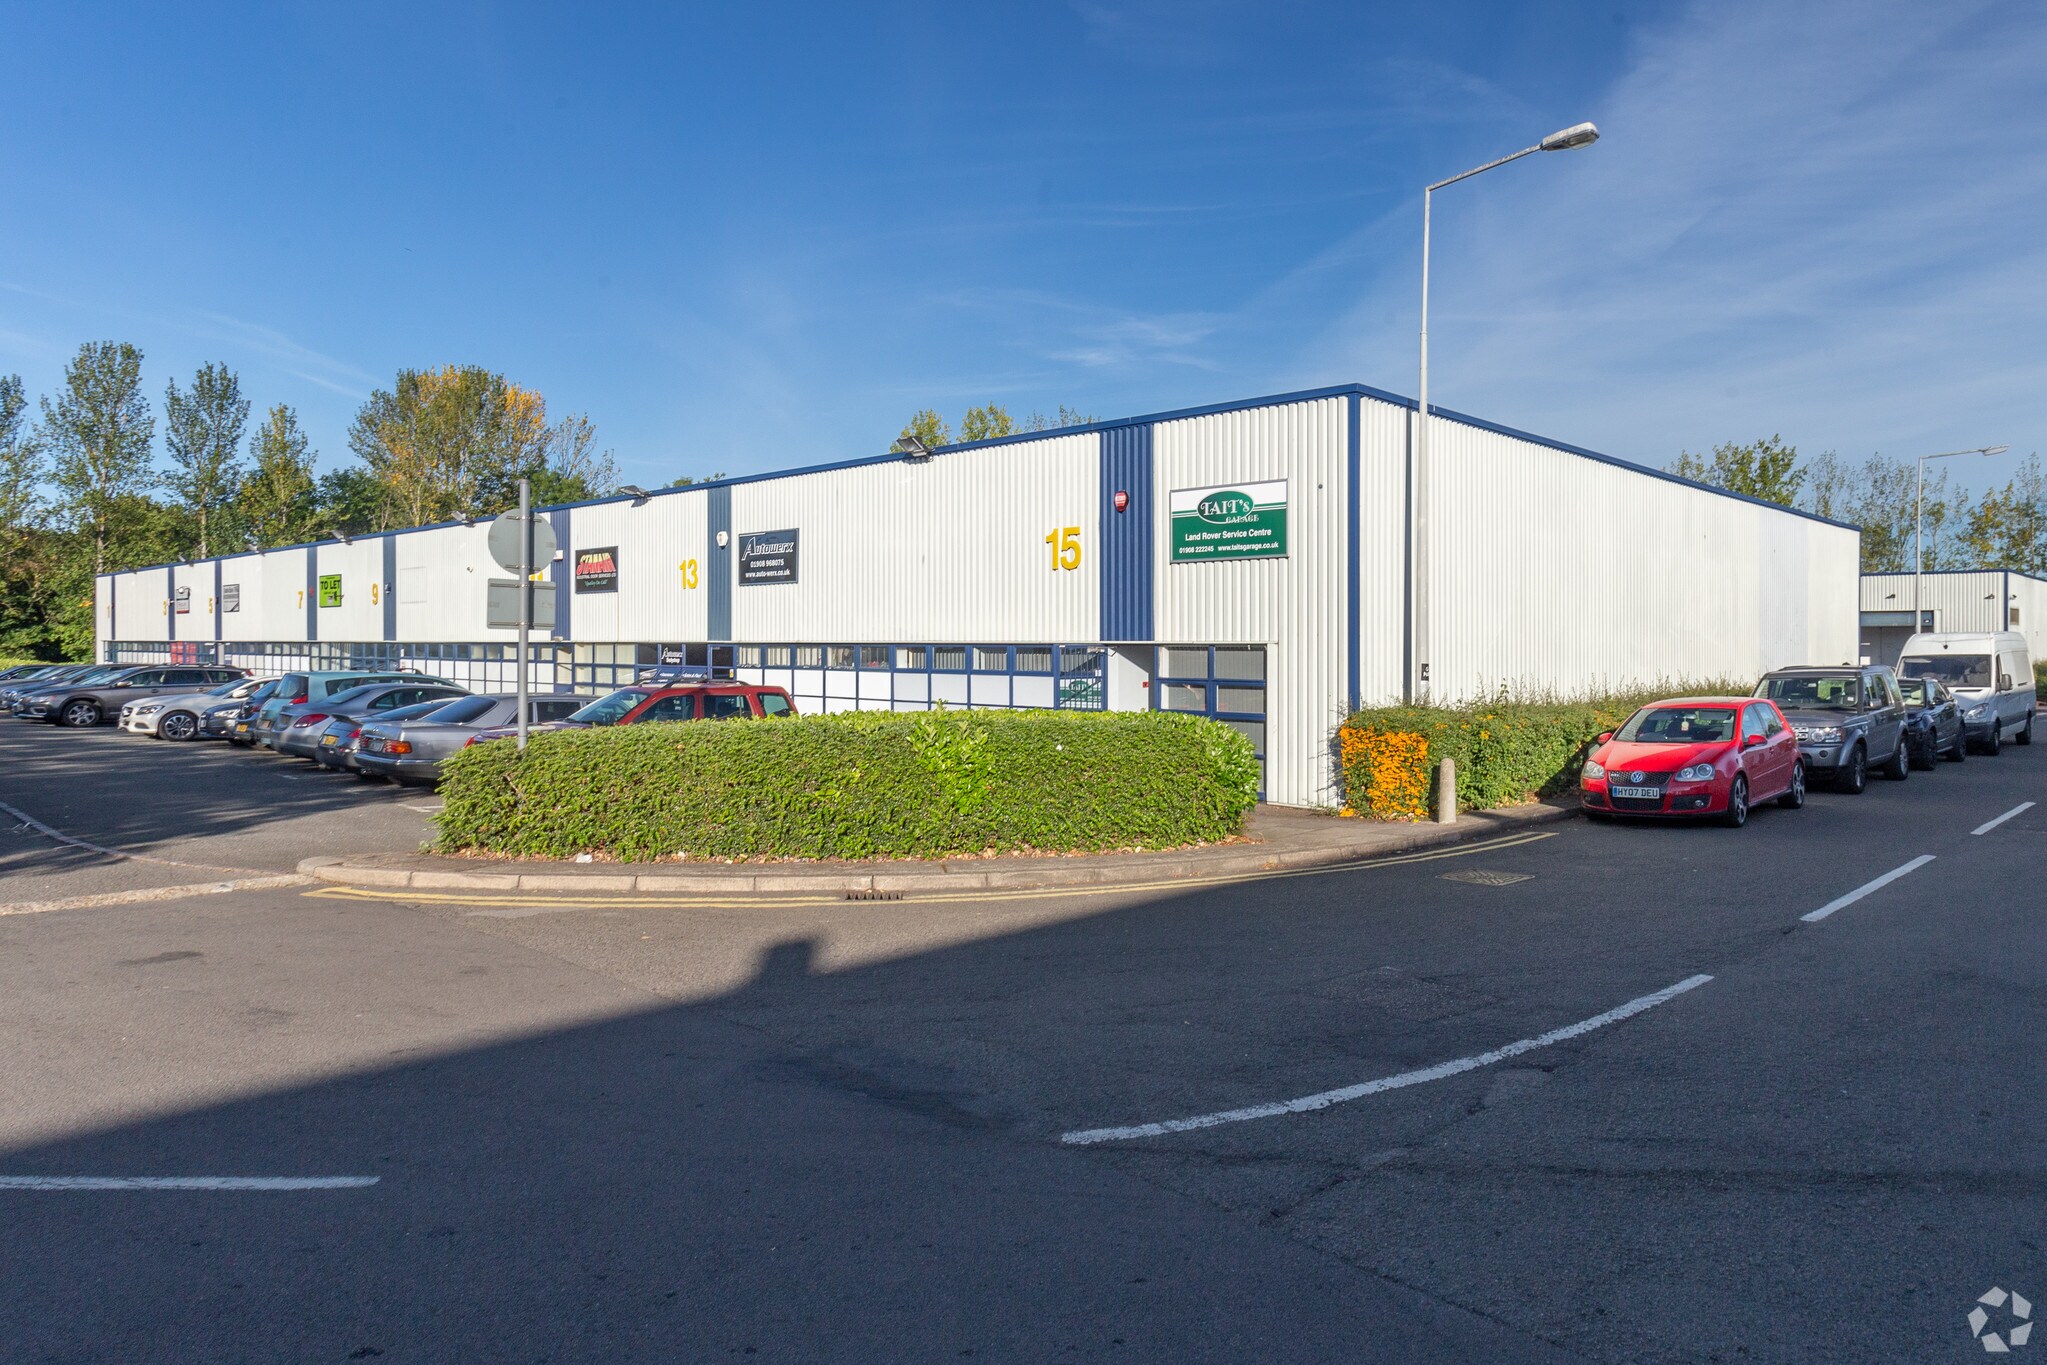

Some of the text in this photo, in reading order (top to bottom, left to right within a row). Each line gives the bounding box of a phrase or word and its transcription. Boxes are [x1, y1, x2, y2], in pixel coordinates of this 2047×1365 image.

[1225, 513, 1259, 524] GARAGE
[1184, 528, 1272, 541] Land Rover Service Centre
[741, 536, 794, 561] Autowerx
[1045, 526, 1081, 571] 15
[1217, 541, 1279, 552] www.taitsgarage.co.uk
[679, 558, 698, 589] 13
[320, 579, 340, 590] TO LET
[298, 591, 303, 609] 7
[372, 583, 378, 605] 9
[1617, 788, 1658, 797] HY07 DEU
